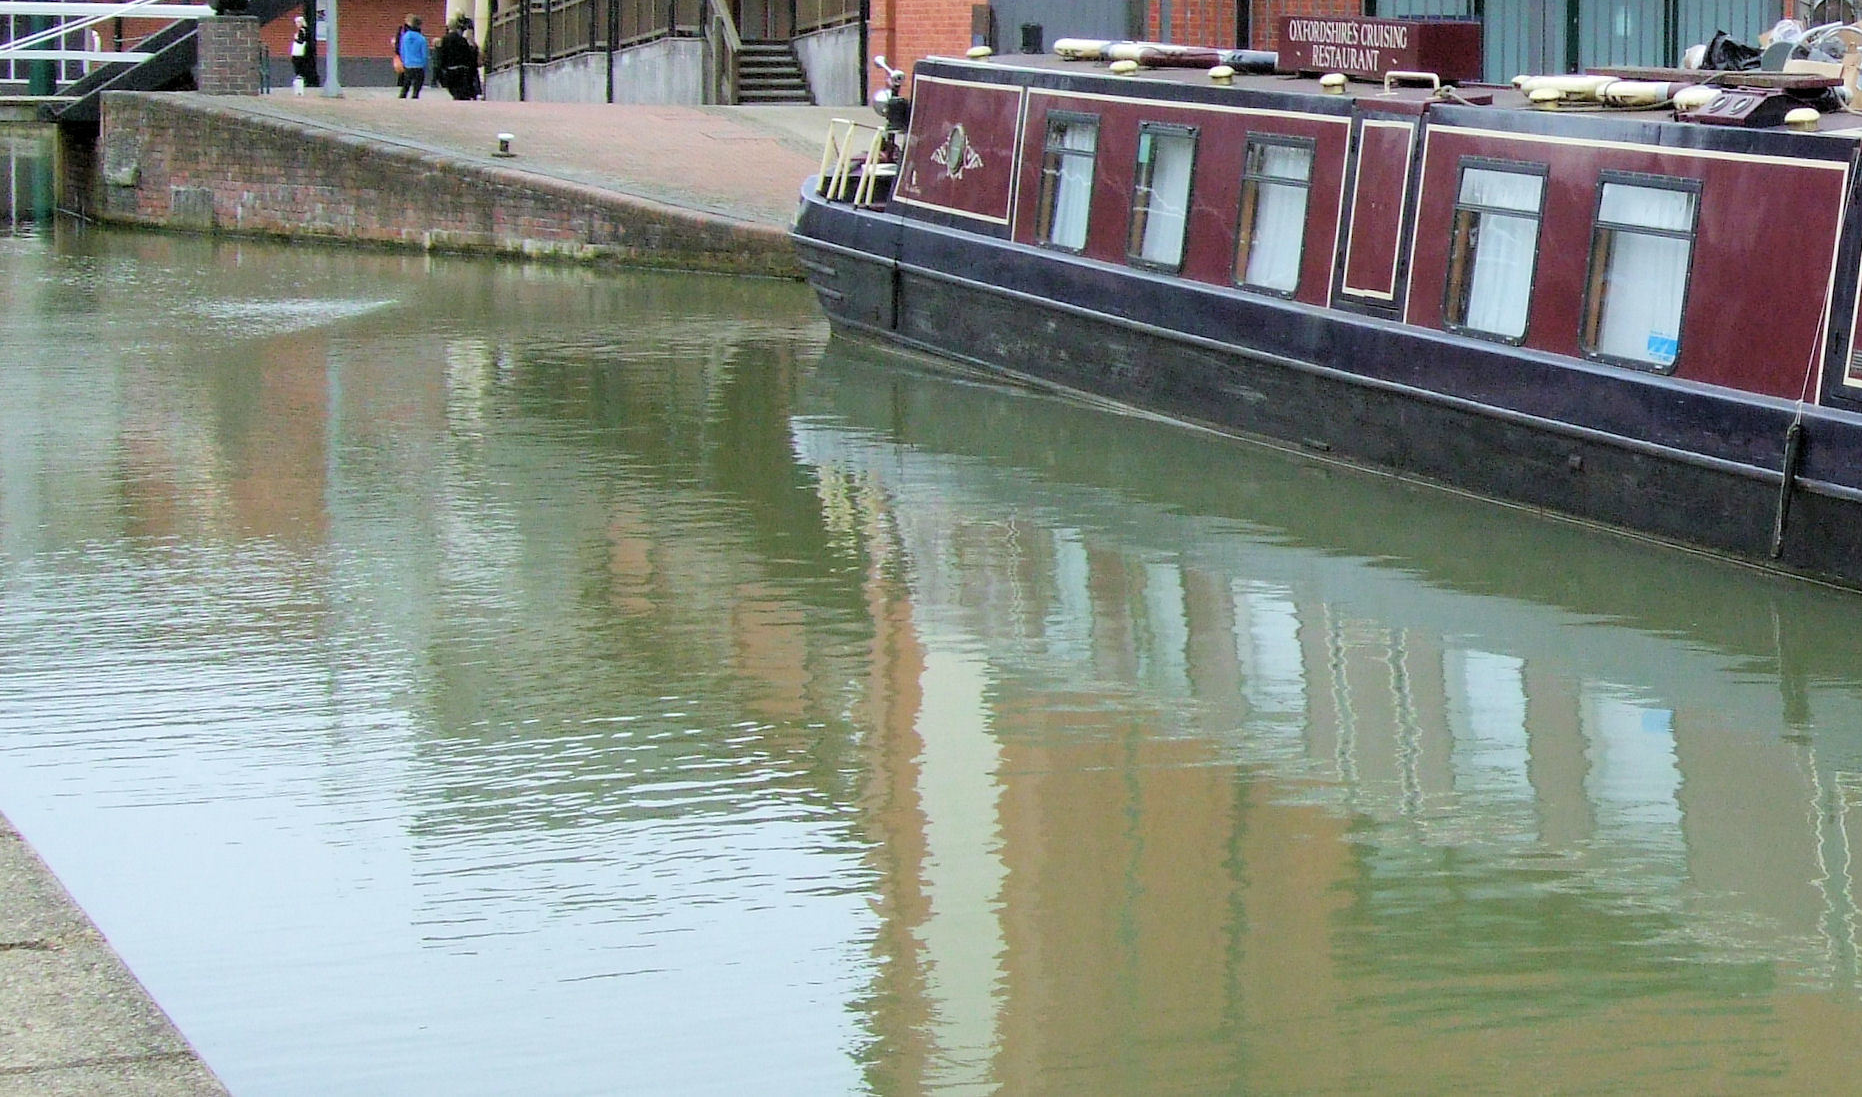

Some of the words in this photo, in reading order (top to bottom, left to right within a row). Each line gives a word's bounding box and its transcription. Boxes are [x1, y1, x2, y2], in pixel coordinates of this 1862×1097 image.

[1289, 19, 1359, 45] OXFORDSHIRE'S
[1360, 23, 1407, 49] CRUISING
[1312, 44, 1380, 71] RESTAURANT
